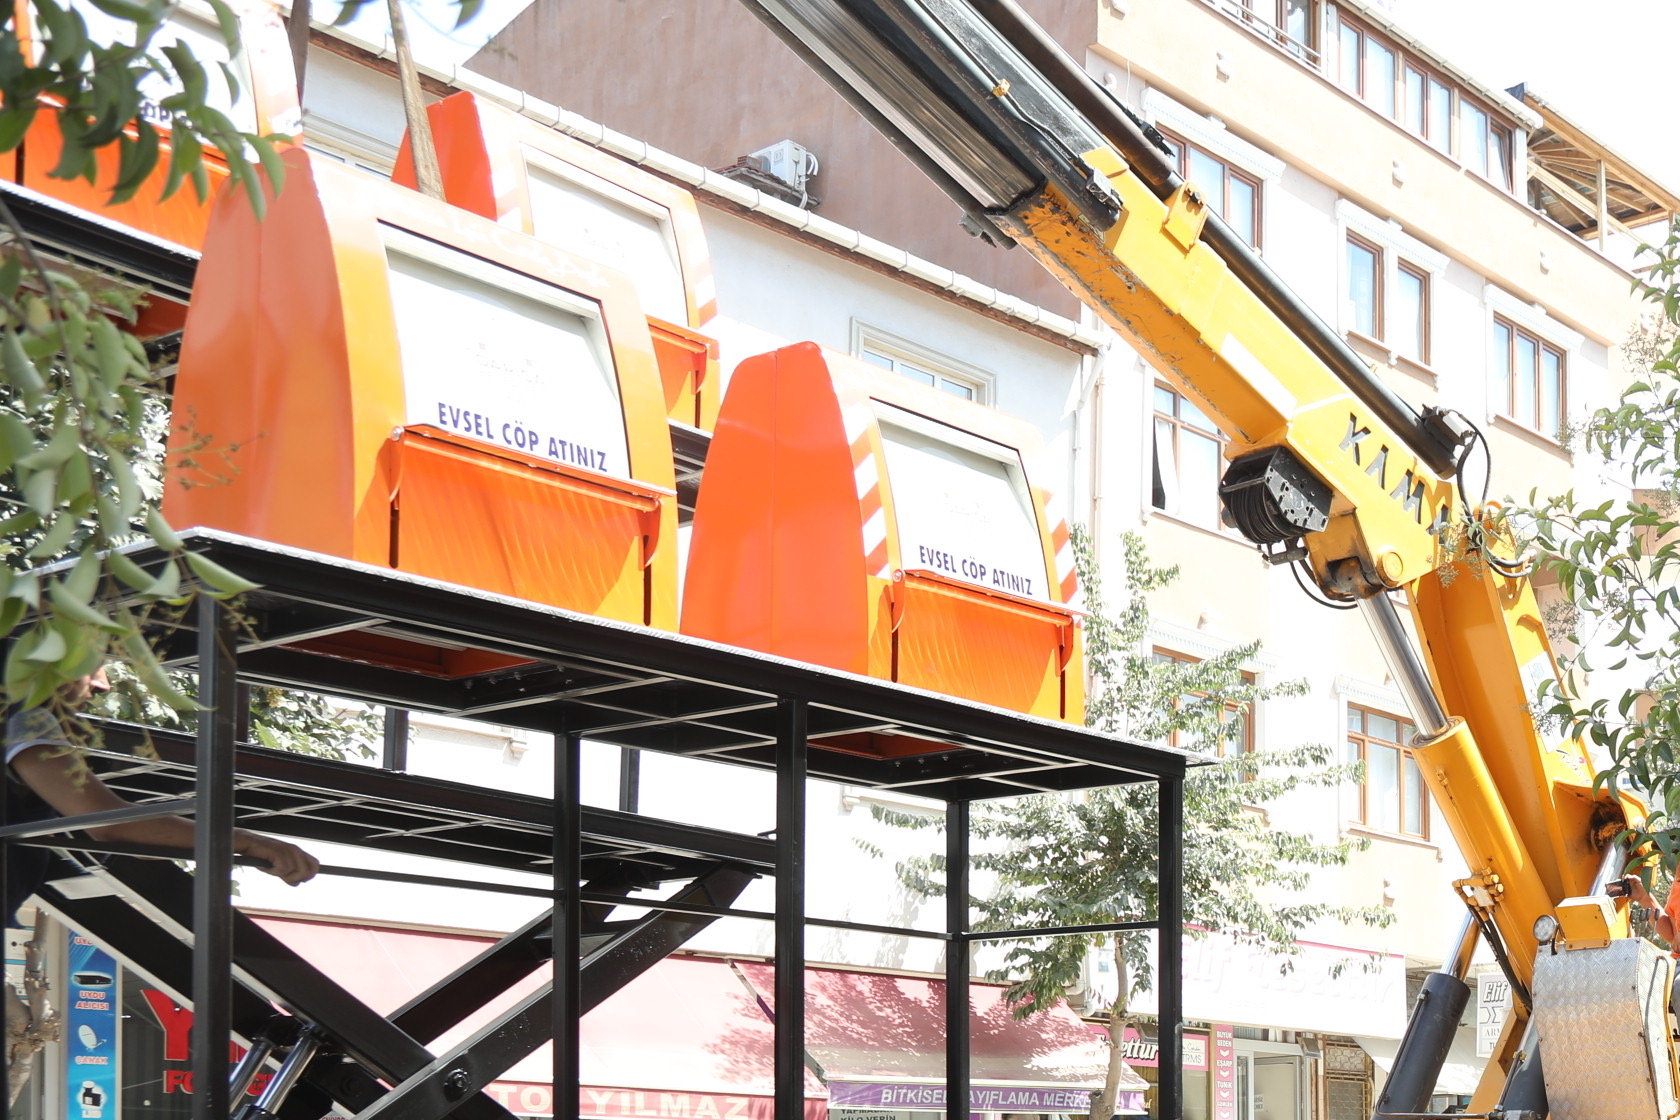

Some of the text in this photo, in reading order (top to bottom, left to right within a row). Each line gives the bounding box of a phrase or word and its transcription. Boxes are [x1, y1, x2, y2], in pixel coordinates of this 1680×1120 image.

[438, 402, 494, 439] EVSEL
[549, 437, 608, 472] ATINIZ
[919, 545, 957, 573] EVSEL
[993, 568, 1033, 596] ATINIZ
[488, 1085, 750, 1120] TO YILMAZ
[969, 1089, 1039, 1106] AYIFLAMA
[1043, 1090, 1091, 1109] MERKE
